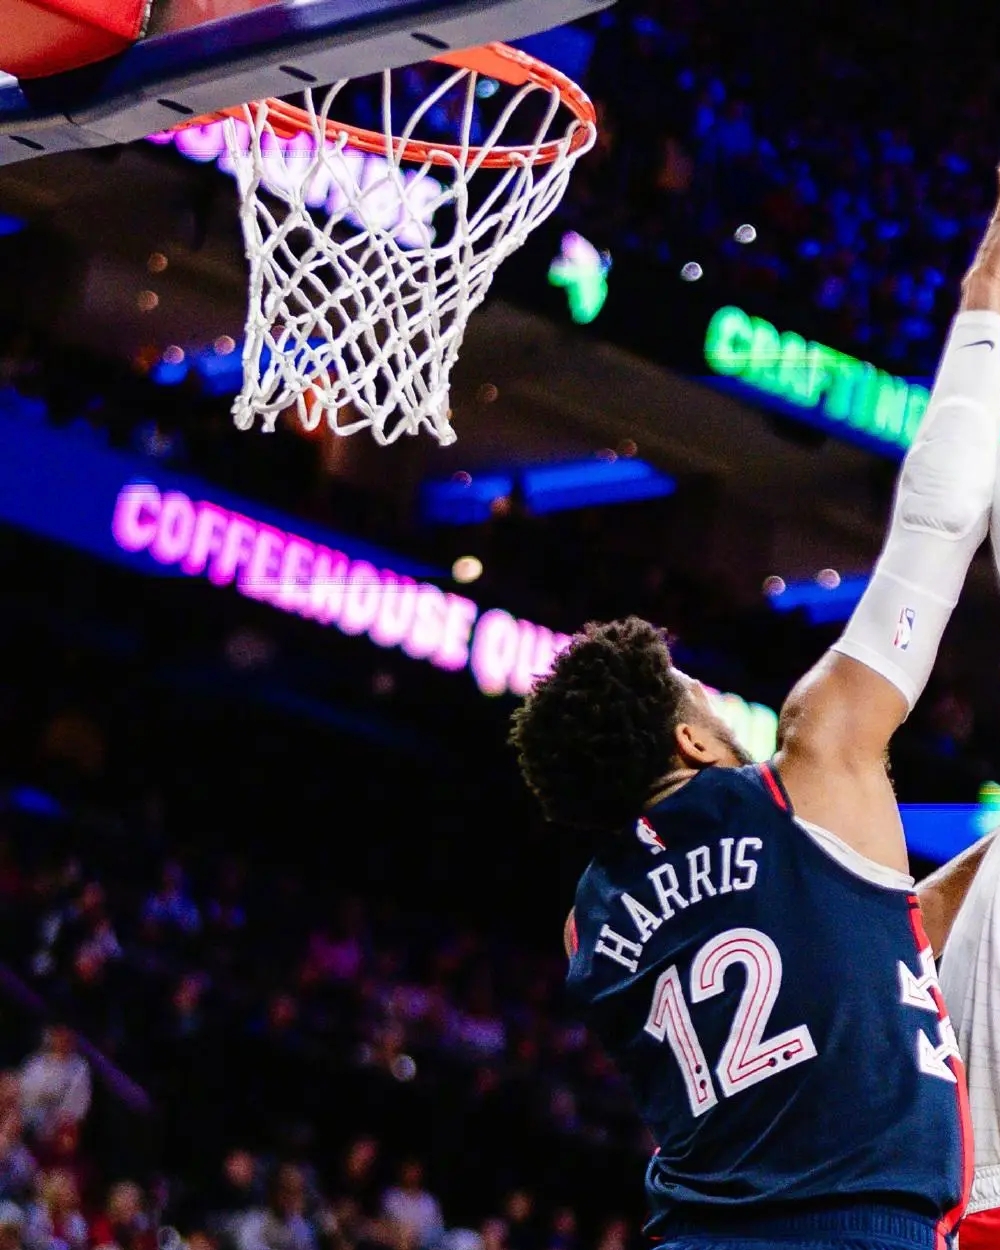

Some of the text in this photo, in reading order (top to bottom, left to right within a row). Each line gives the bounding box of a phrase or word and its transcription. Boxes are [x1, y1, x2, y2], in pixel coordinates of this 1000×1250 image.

[110, 482, 478, 672] COFFEEHOUSE
[595, 836, 763, 974] HARRIS
[643, 927, 819, 1118] 12
